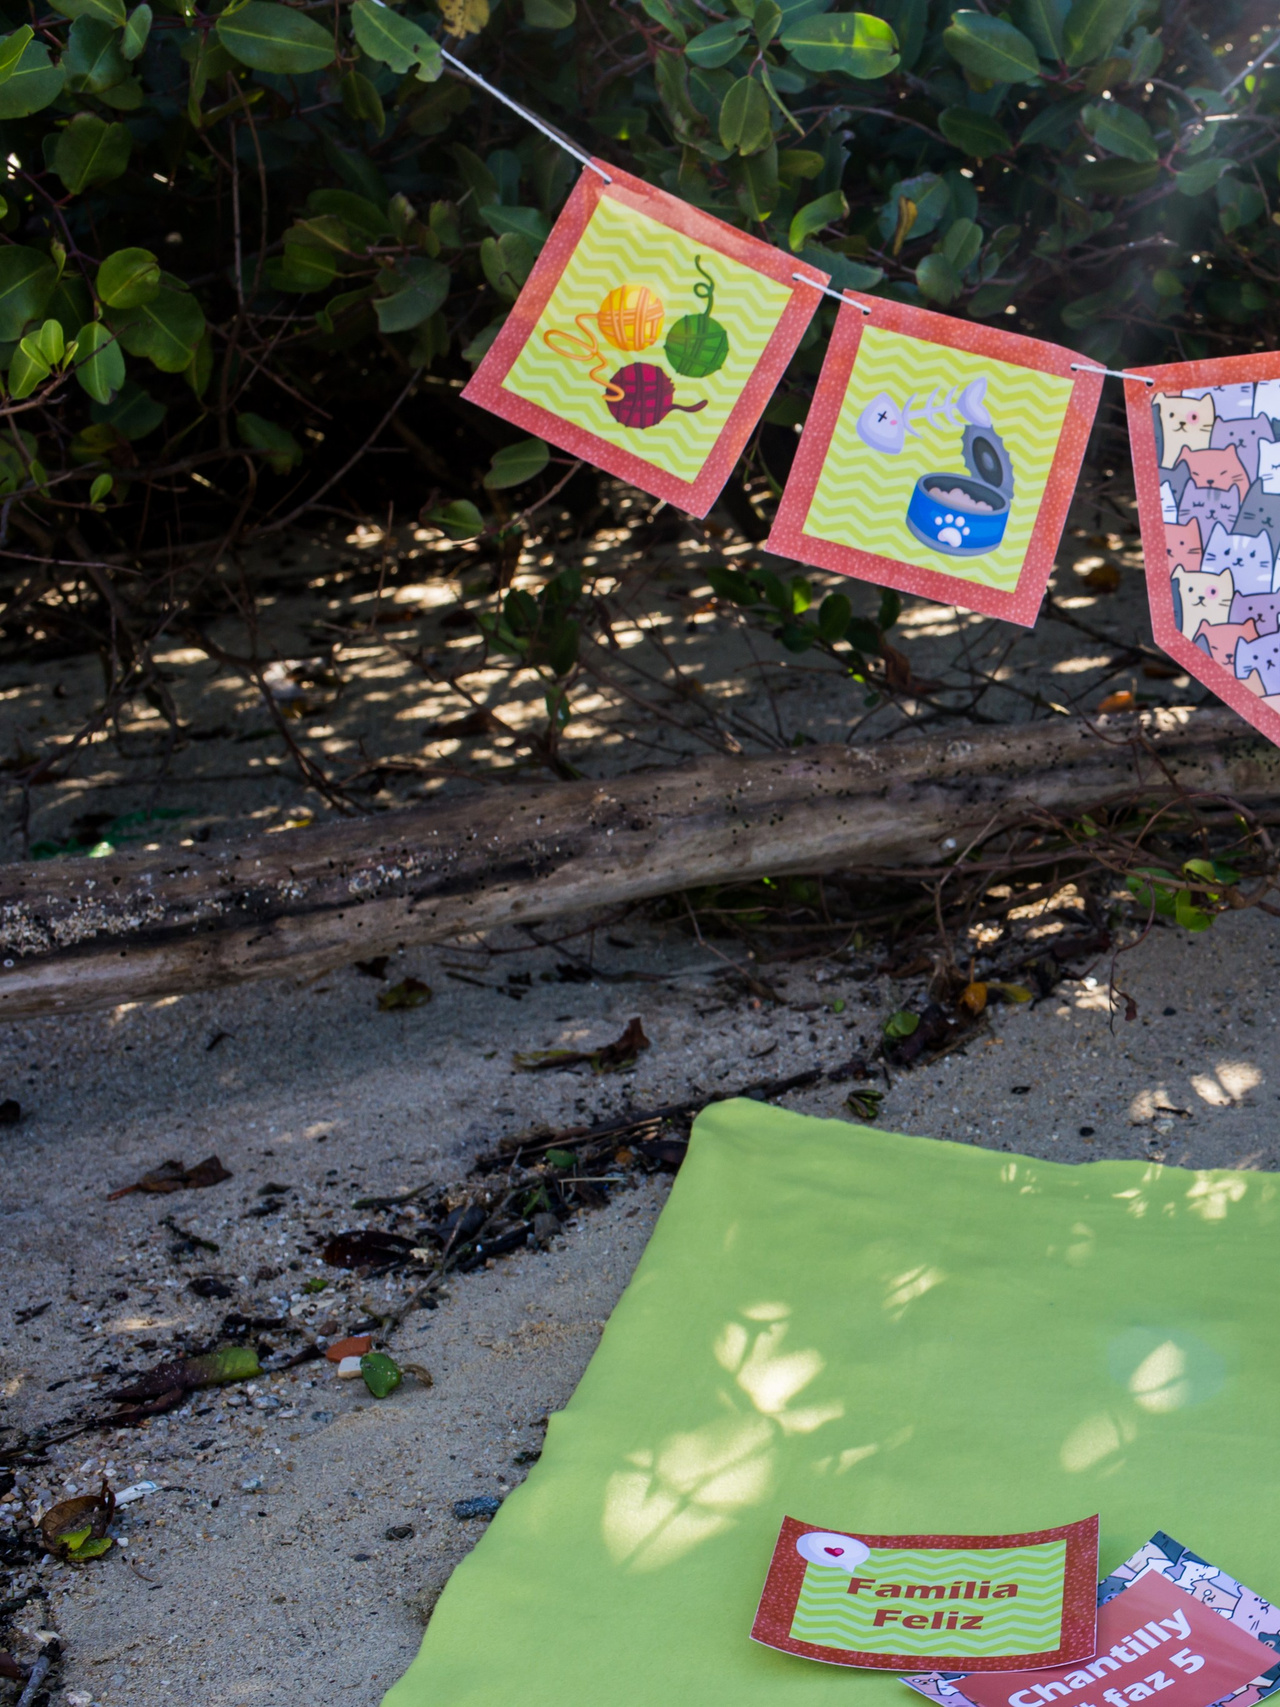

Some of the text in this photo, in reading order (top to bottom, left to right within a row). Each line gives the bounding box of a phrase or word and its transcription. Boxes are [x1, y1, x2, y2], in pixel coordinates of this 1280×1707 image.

[847, 1577, 1019, 1600] Família
[872, 1609, 984, 1630] Feliz
[1008, 1608, 1192, 1707] Chantilly
[1102, 1648, 1205, 1707] faz 5
